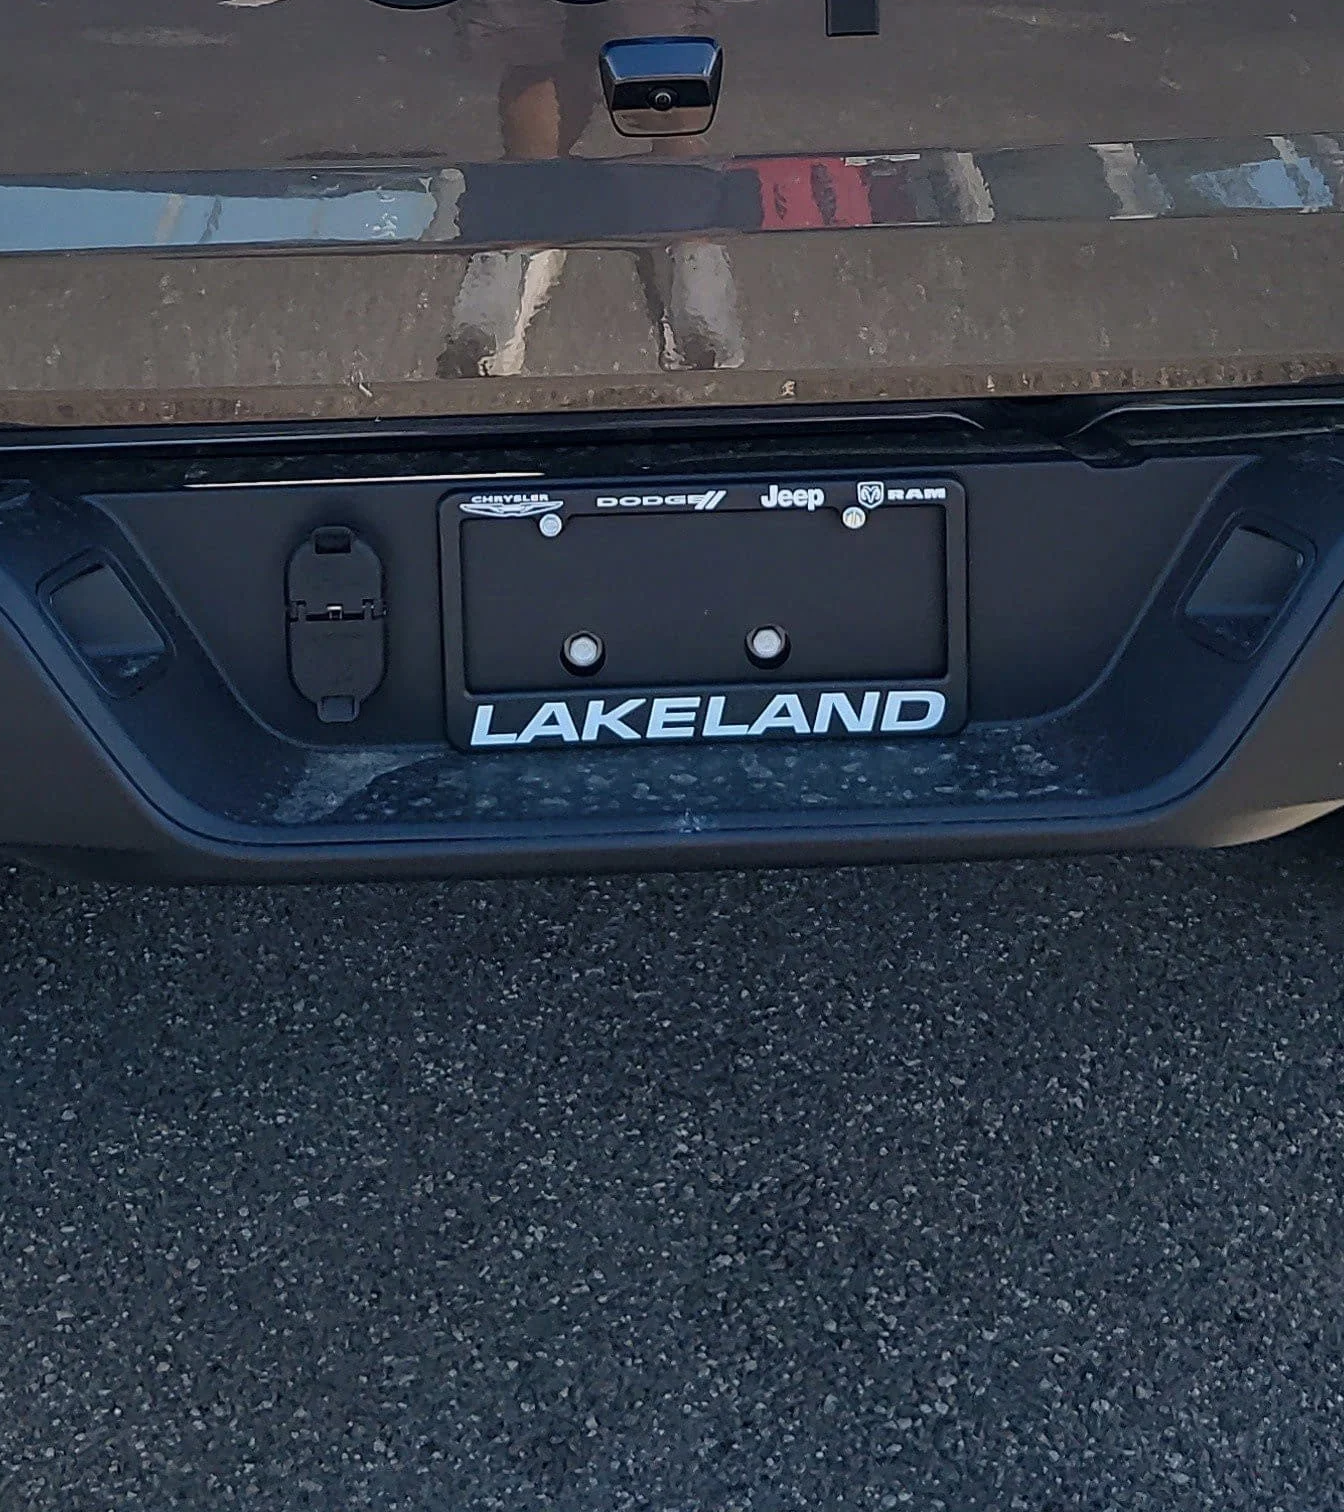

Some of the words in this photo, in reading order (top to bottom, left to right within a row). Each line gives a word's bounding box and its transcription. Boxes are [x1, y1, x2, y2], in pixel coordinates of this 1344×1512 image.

[471, 493, 550, 504] CHRYSLER
[761, 484, 825, 511] Jeep
[887, 488, 947, 500] RAM
[596, 495, 702, 508] DODGE
[469, 690, 946, 747] LAKELAND
